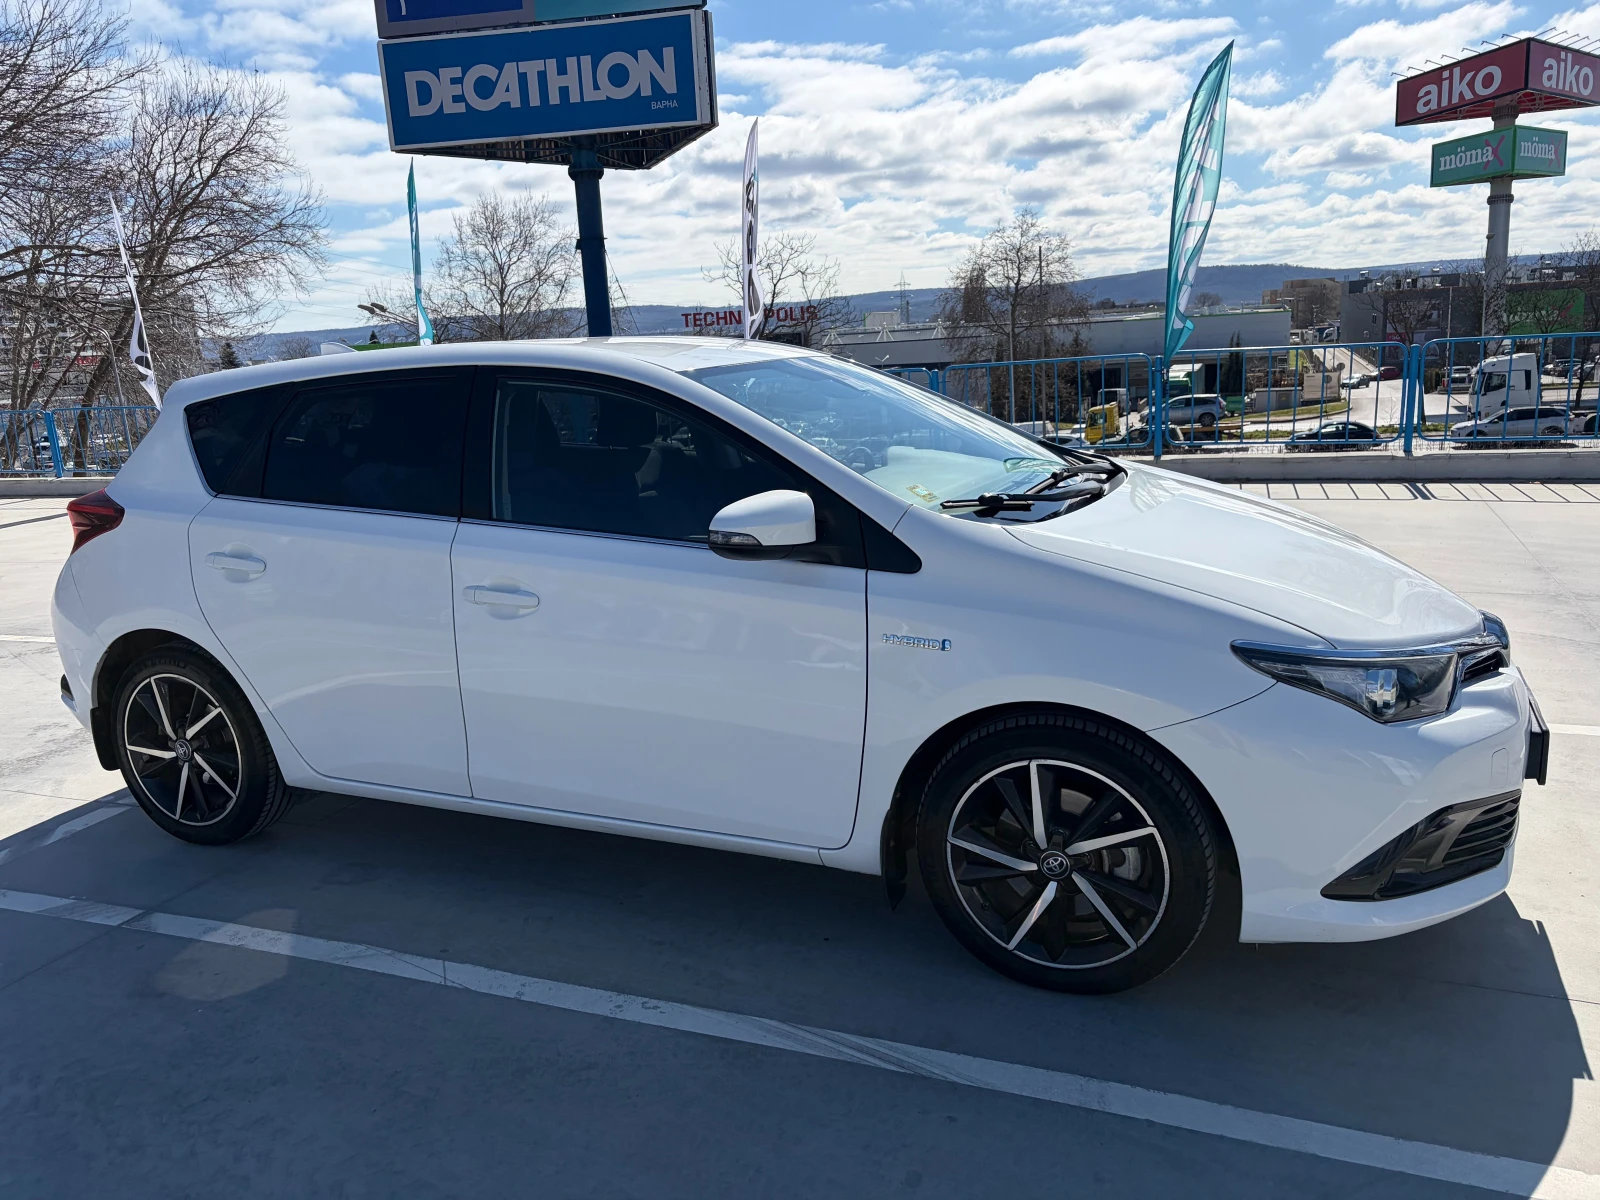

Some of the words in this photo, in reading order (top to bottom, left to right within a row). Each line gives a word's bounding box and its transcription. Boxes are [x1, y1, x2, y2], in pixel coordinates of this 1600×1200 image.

[404, 47, 677, 117] DECATHLON
[1416, 65, 1502, 114] aiko
[1542, 51, 1594, 96] aiko
[681, 304, 818, 328] TECHNPOLIS
[882, 633, 940, 651] HYBRID
